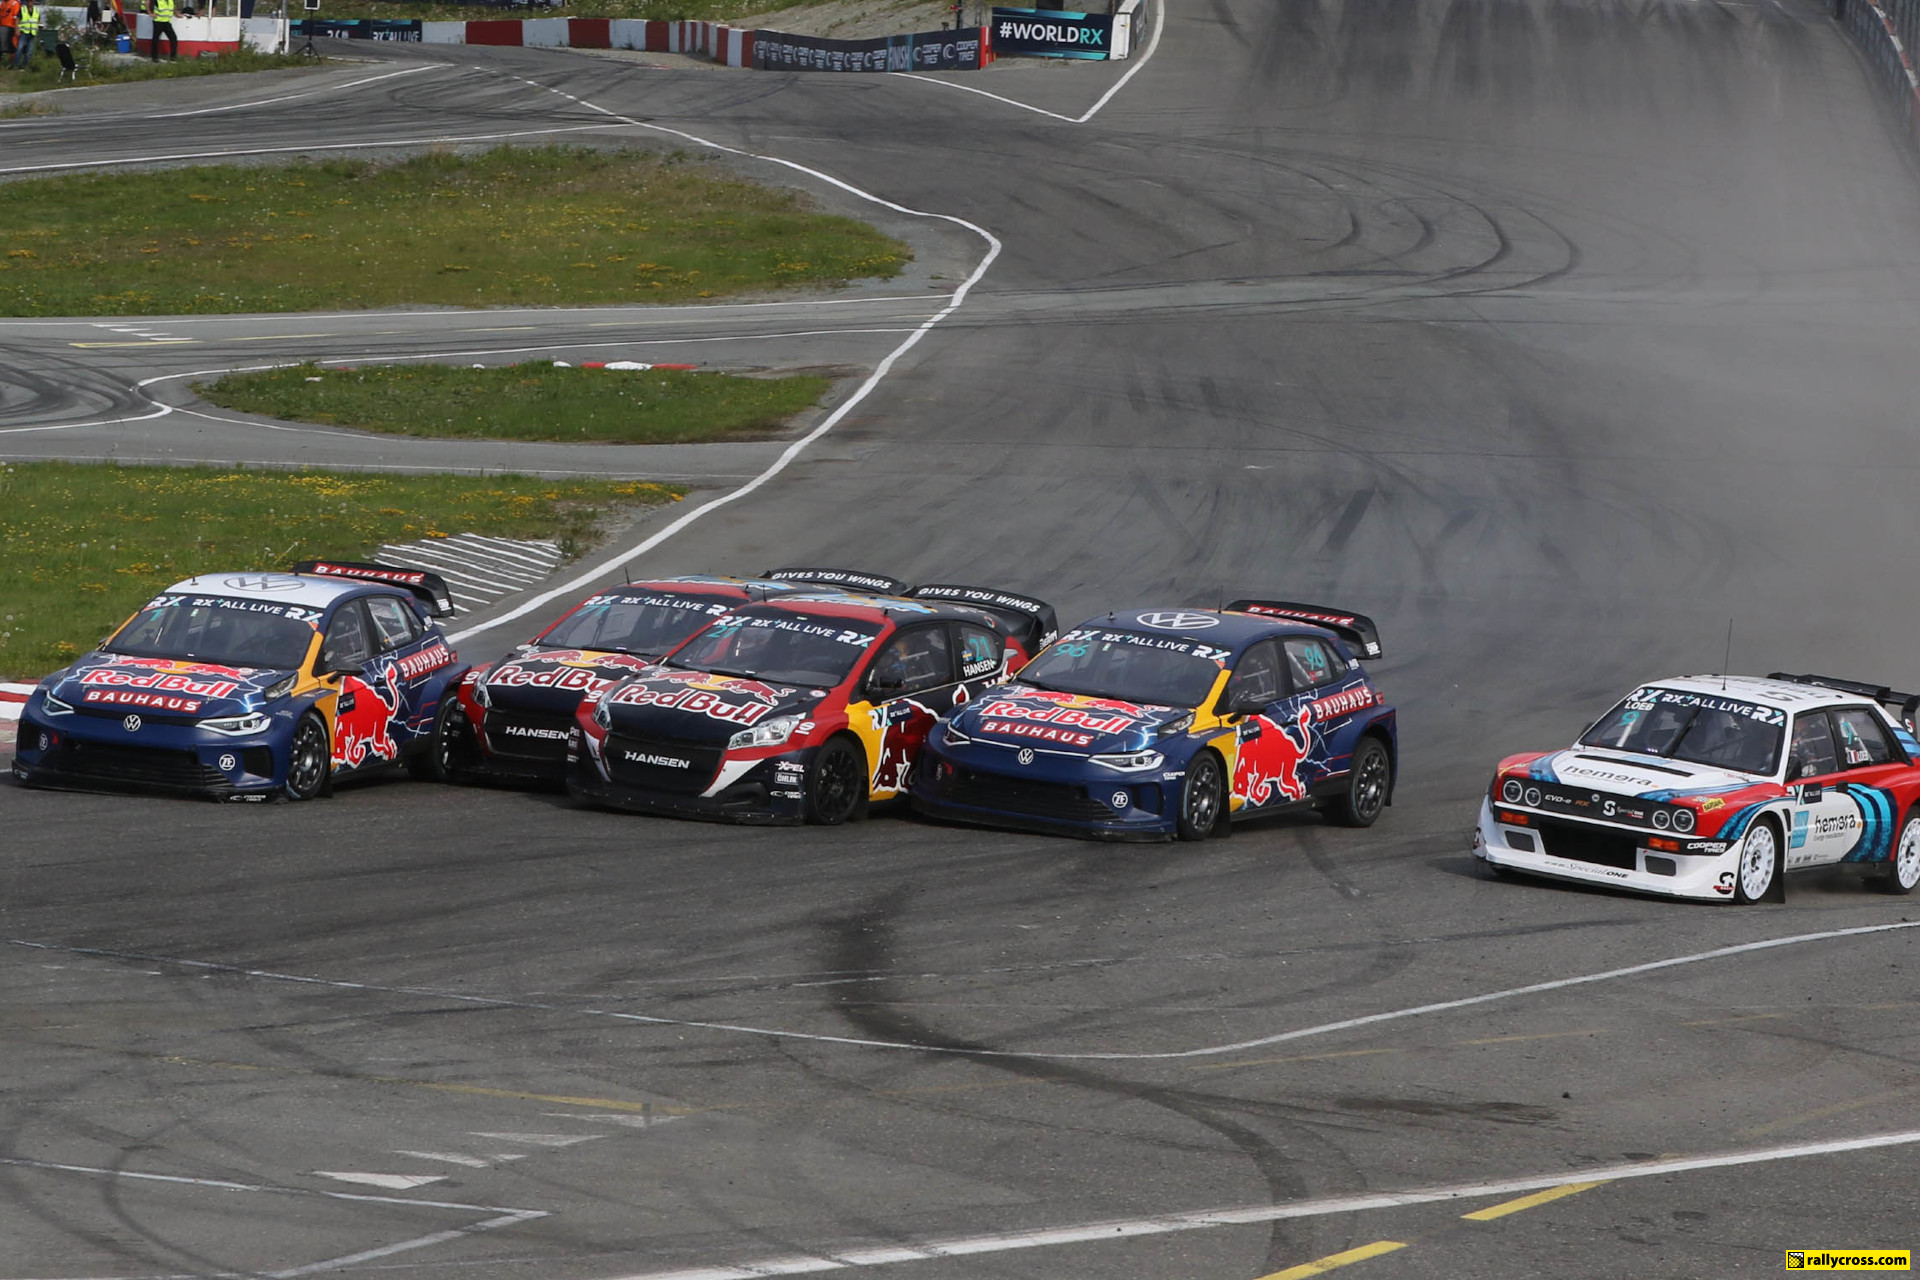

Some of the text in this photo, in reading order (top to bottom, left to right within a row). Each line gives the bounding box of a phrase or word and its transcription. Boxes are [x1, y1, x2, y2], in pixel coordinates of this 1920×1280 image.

[1000, 22, 1104, 45] #WORLDRX
[314, 564, 425, 583] BAUHAUS
[771, 570, 892, 590] GIVES YOU WINGS
[672, 600, 705, 611] LIVE
[918, 586, 961, 597] GIVES
[964, 589, 995, 601] YOU
[995, 595, 1041, 613] WINGS
[249, 604, 284, 616] LIVE
[1248, 605, 1355, 626] BAUHAUS
[803, 623, 836, 638] LIVE
[1159, 638, 1190, 652] LIVE
[400, 647, 450, 679] BAUHAUS
[1304, 643, 1325, 671] 96
[486, 665, 560, 688] Red
[963, 658, 995, 678] HANSEN
[80, 668, 239, 699] Red Bull
[86, 690, 200, 712] BAUHAUS
[610, 683, 774, 727] Red Bull
[1313, 688, 1373, 720] BAUHAUS
[1624, 700, 1657, 711] LOEB
[1718, 701, 1753, 717] LIVE
[979, 701, 1136, 735] Red Bull
[505, 725, 570, 740] HANSEN
[982, 720, 1095, 747] BAUHAUS
[219, 754, 236, 771] ZF
[624, 750, 691, 770] HANSEN
[778, 760, 805, 773] XPEL
[1112, 791, 1129, 808] ZF
[1545, 794, 1572, 805] EVO-e
[1686, 842, 1728, 850] COOPER
